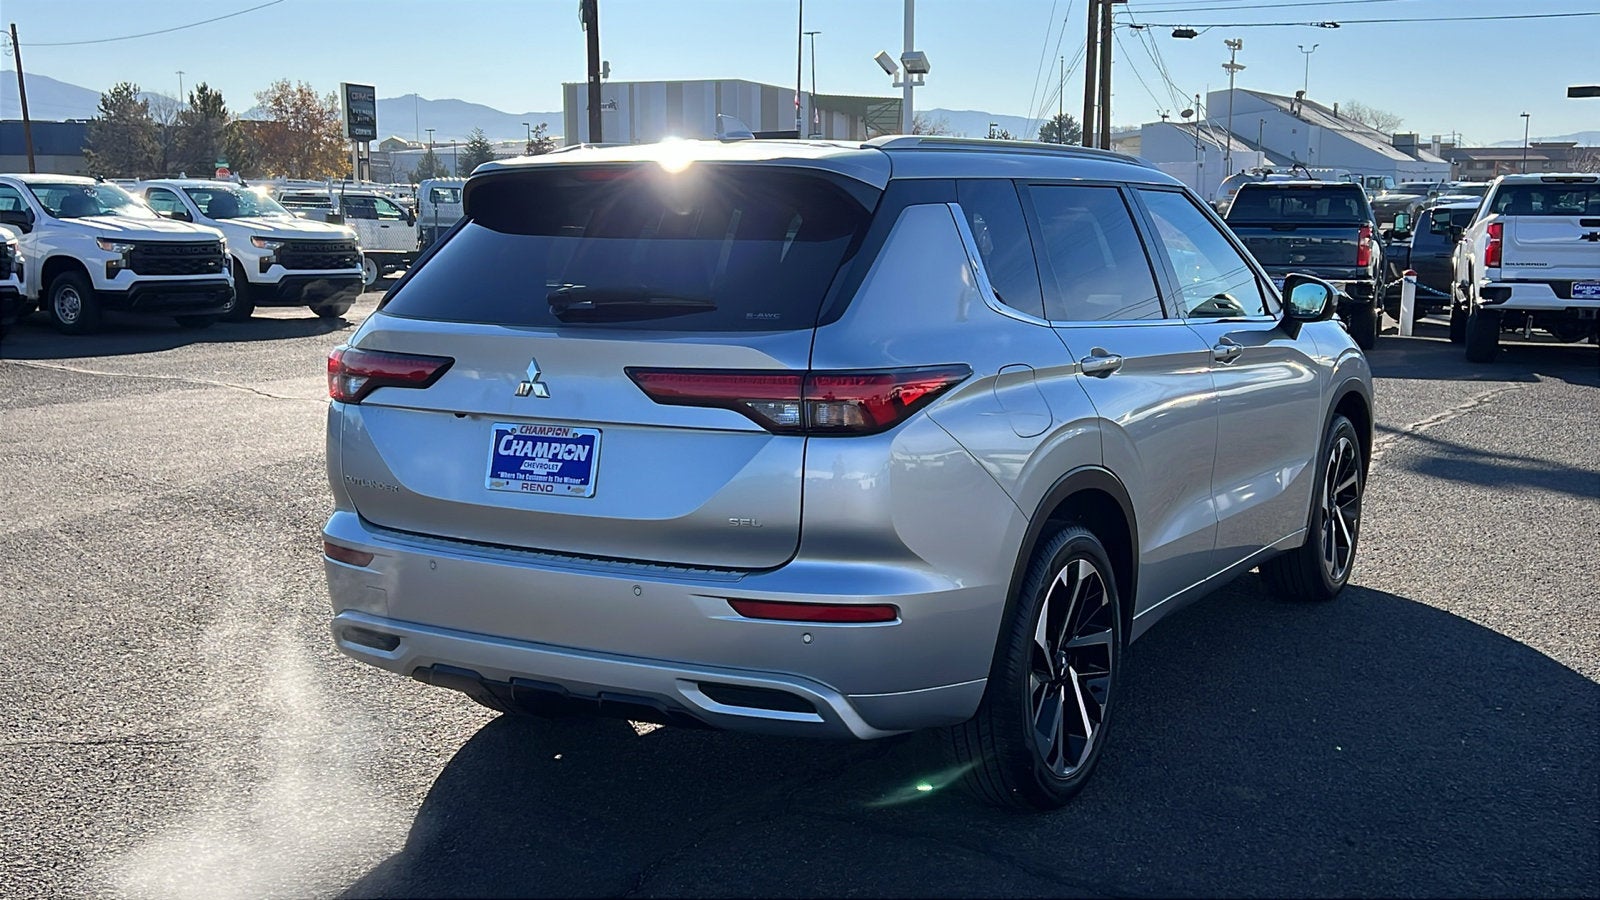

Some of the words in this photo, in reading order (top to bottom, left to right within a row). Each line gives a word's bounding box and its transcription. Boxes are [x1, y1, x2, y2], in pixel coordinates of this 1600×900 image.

[351, 92, 373, 101] GMC
[519, 425, 569, 437] CHAMPION
[498, 434, 590, 462] CHAMPION
[523, 461, 559, 471] CHEVROLET
[345, 474, 399, 492] OUTLANDER
[521, 482, 554, 493] RENO
[729, 517, 761, 527] SEL
